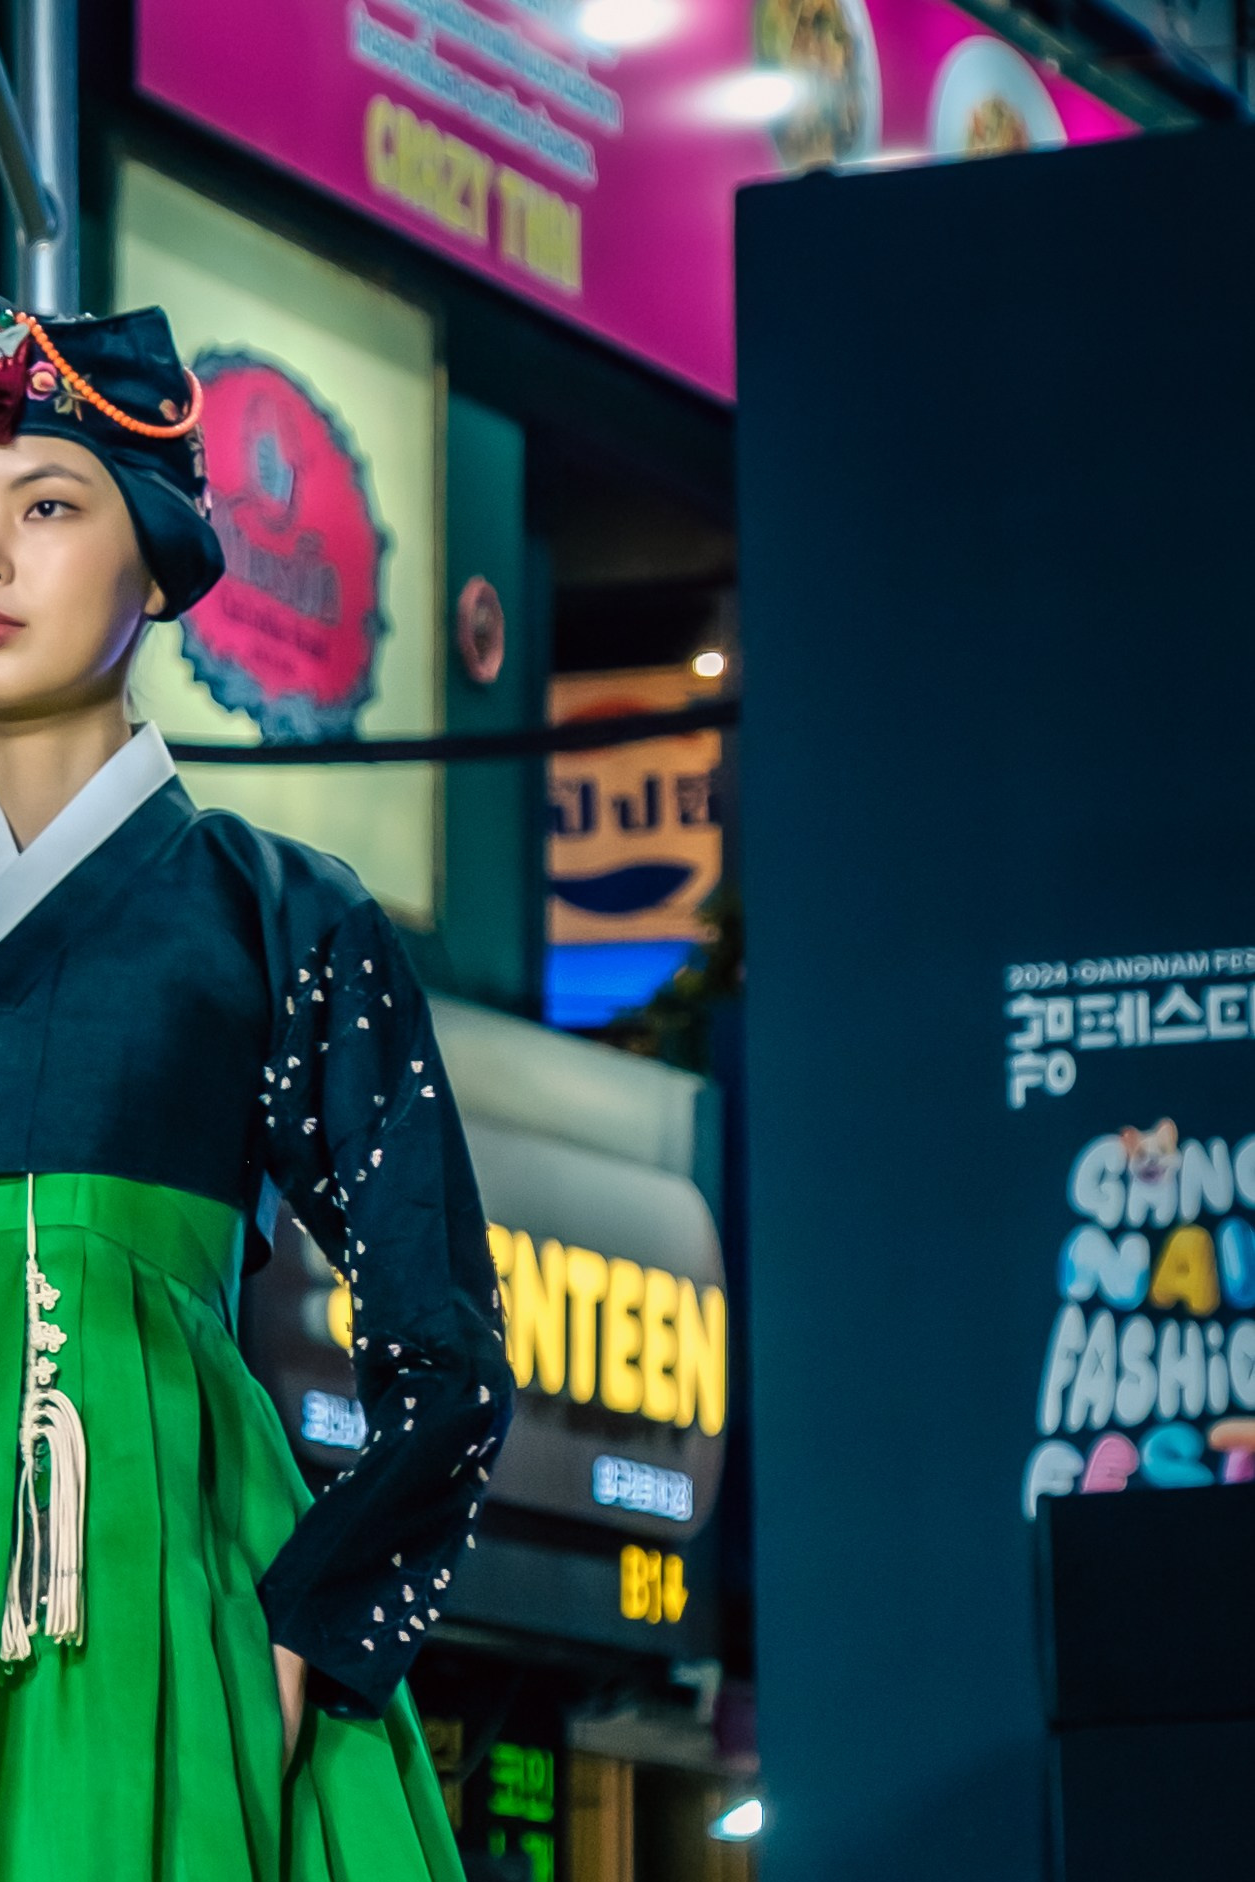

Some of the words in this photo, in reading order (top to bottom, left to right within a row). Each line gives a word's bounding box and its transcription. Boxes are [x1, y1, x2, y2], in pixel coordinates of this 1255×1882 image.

[1004, 963, 1068, 992] 2024
[1072, 950, 1210, 986] GANGNAM
[489, 1222, 726, 1437] NTEEN
